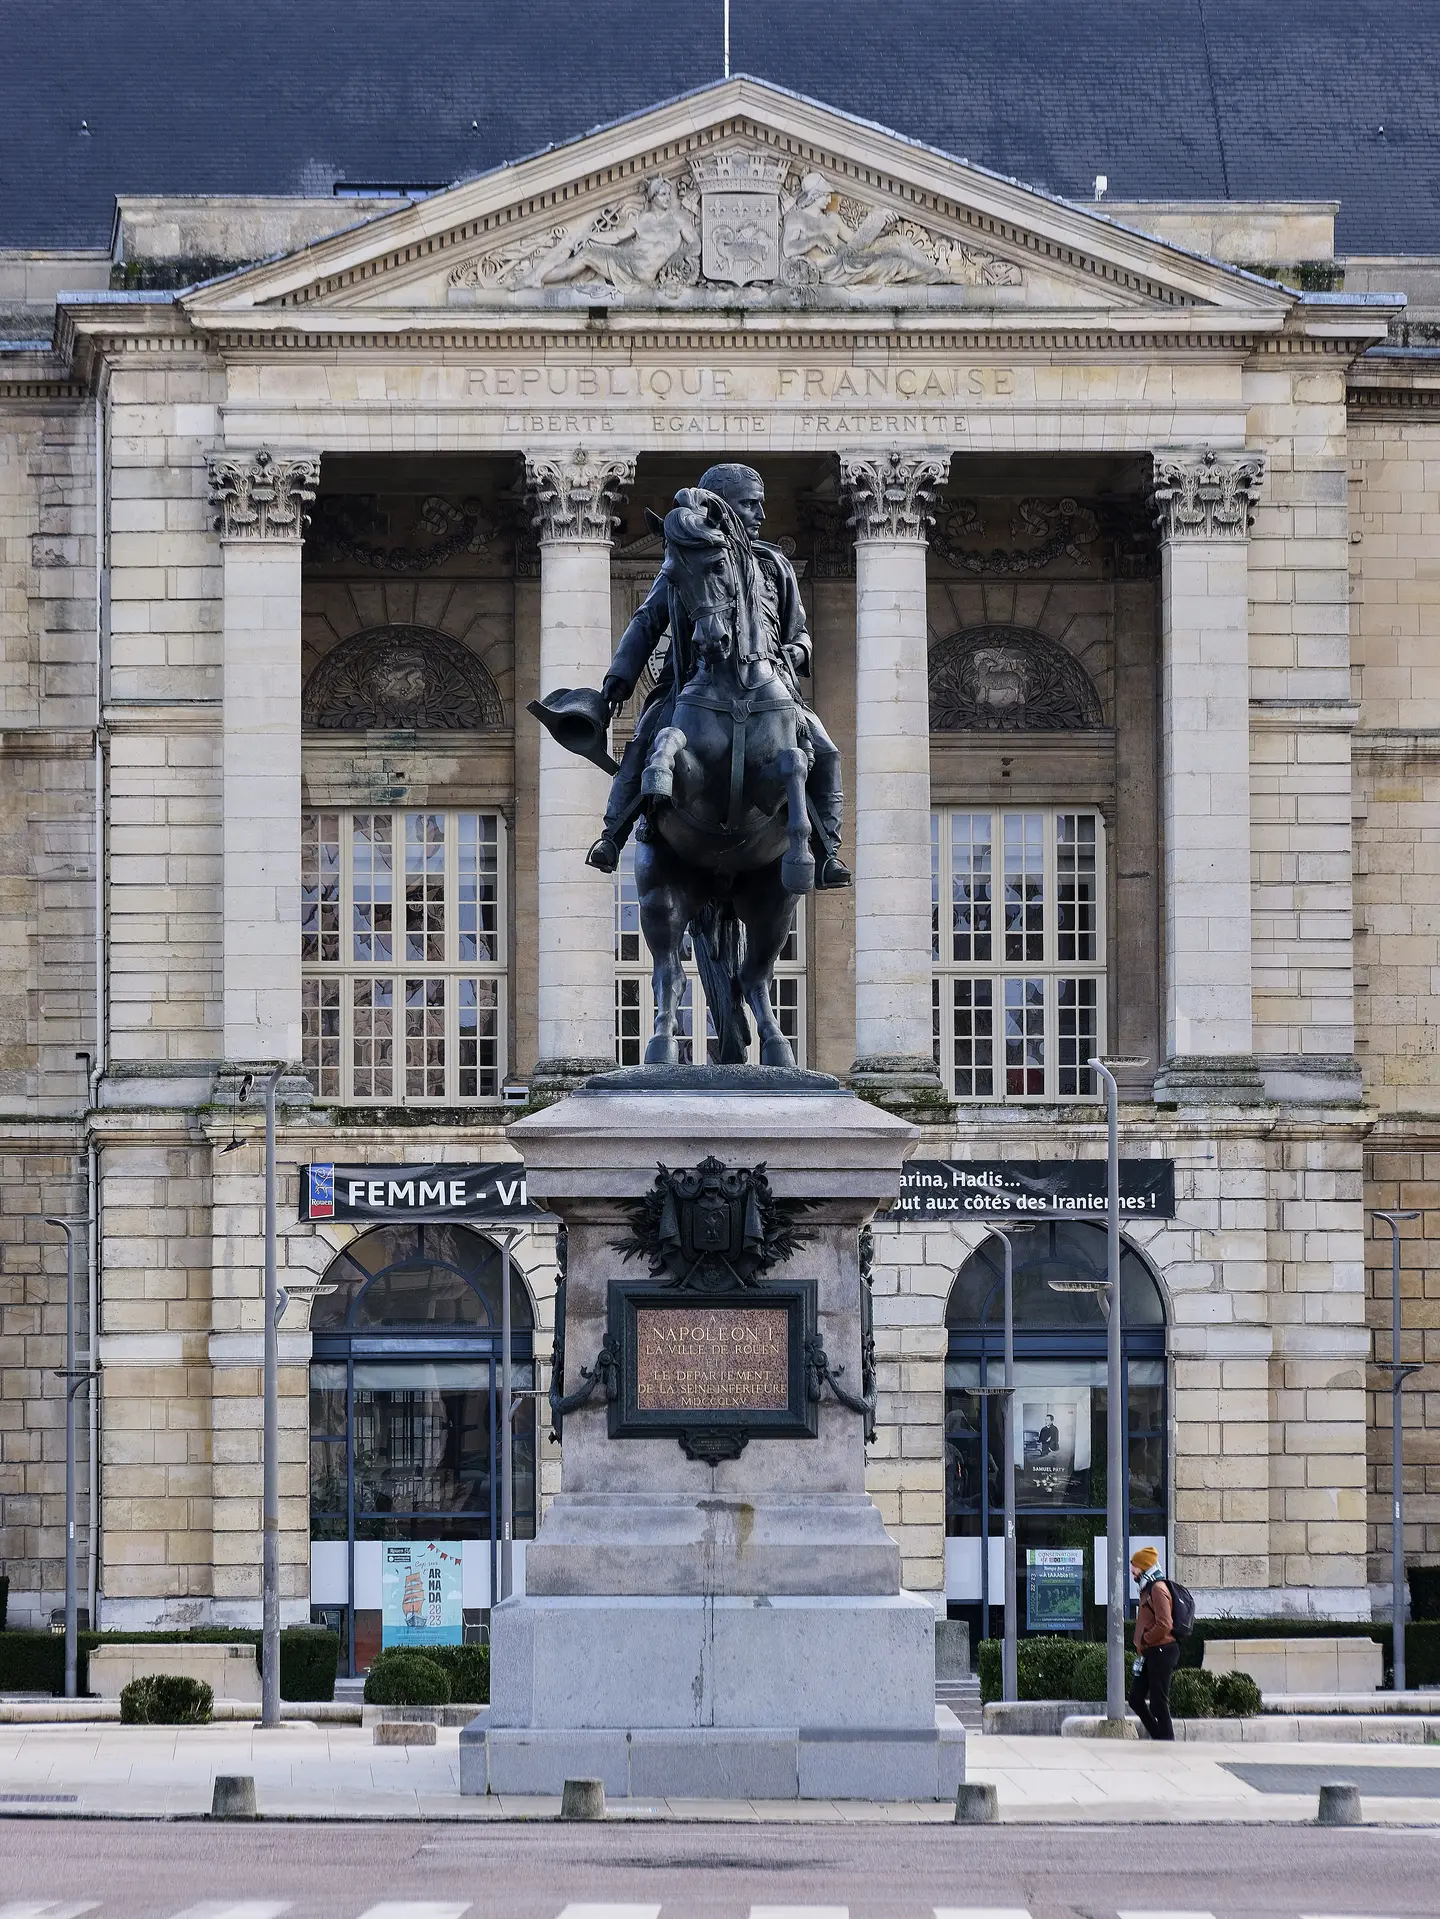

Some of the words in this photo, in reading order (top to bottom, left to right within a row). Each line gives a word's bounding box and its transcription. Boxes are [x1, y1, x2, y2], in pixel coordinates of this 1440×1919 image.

[464, 367, 734, 400] REPUBLIQUE
[777, 368, 1015, 400] FRANÇAISE
[505, 416, 615, 432] LIBERTE
[652, 416, 766, 432] EGALITE
[800, 416, 967, 432] FRATERNITE
[348, 1180, 467, 1206] FEMME
[925, 1197, 959, 1210] aux
[964, 1193, 1011, 1210] côtés
[1016, 1192, 1046, 1210] des
[652, 1327, 759, 1341] NAPOLEON
[646, 1345, 663, 1355] LA
[668, 1345, 706, 1355] VILLE
[711, 1345, 729, 1355] DE
[735, 1344, 779, 1355] ROUEN
[654, 1371, 670, 1380] LE
[677, 1371, 771, 1380] DEPARTEMENT
[639, 1384, 653, 1393] DE
[660, 1384, 675, 1393] LA
